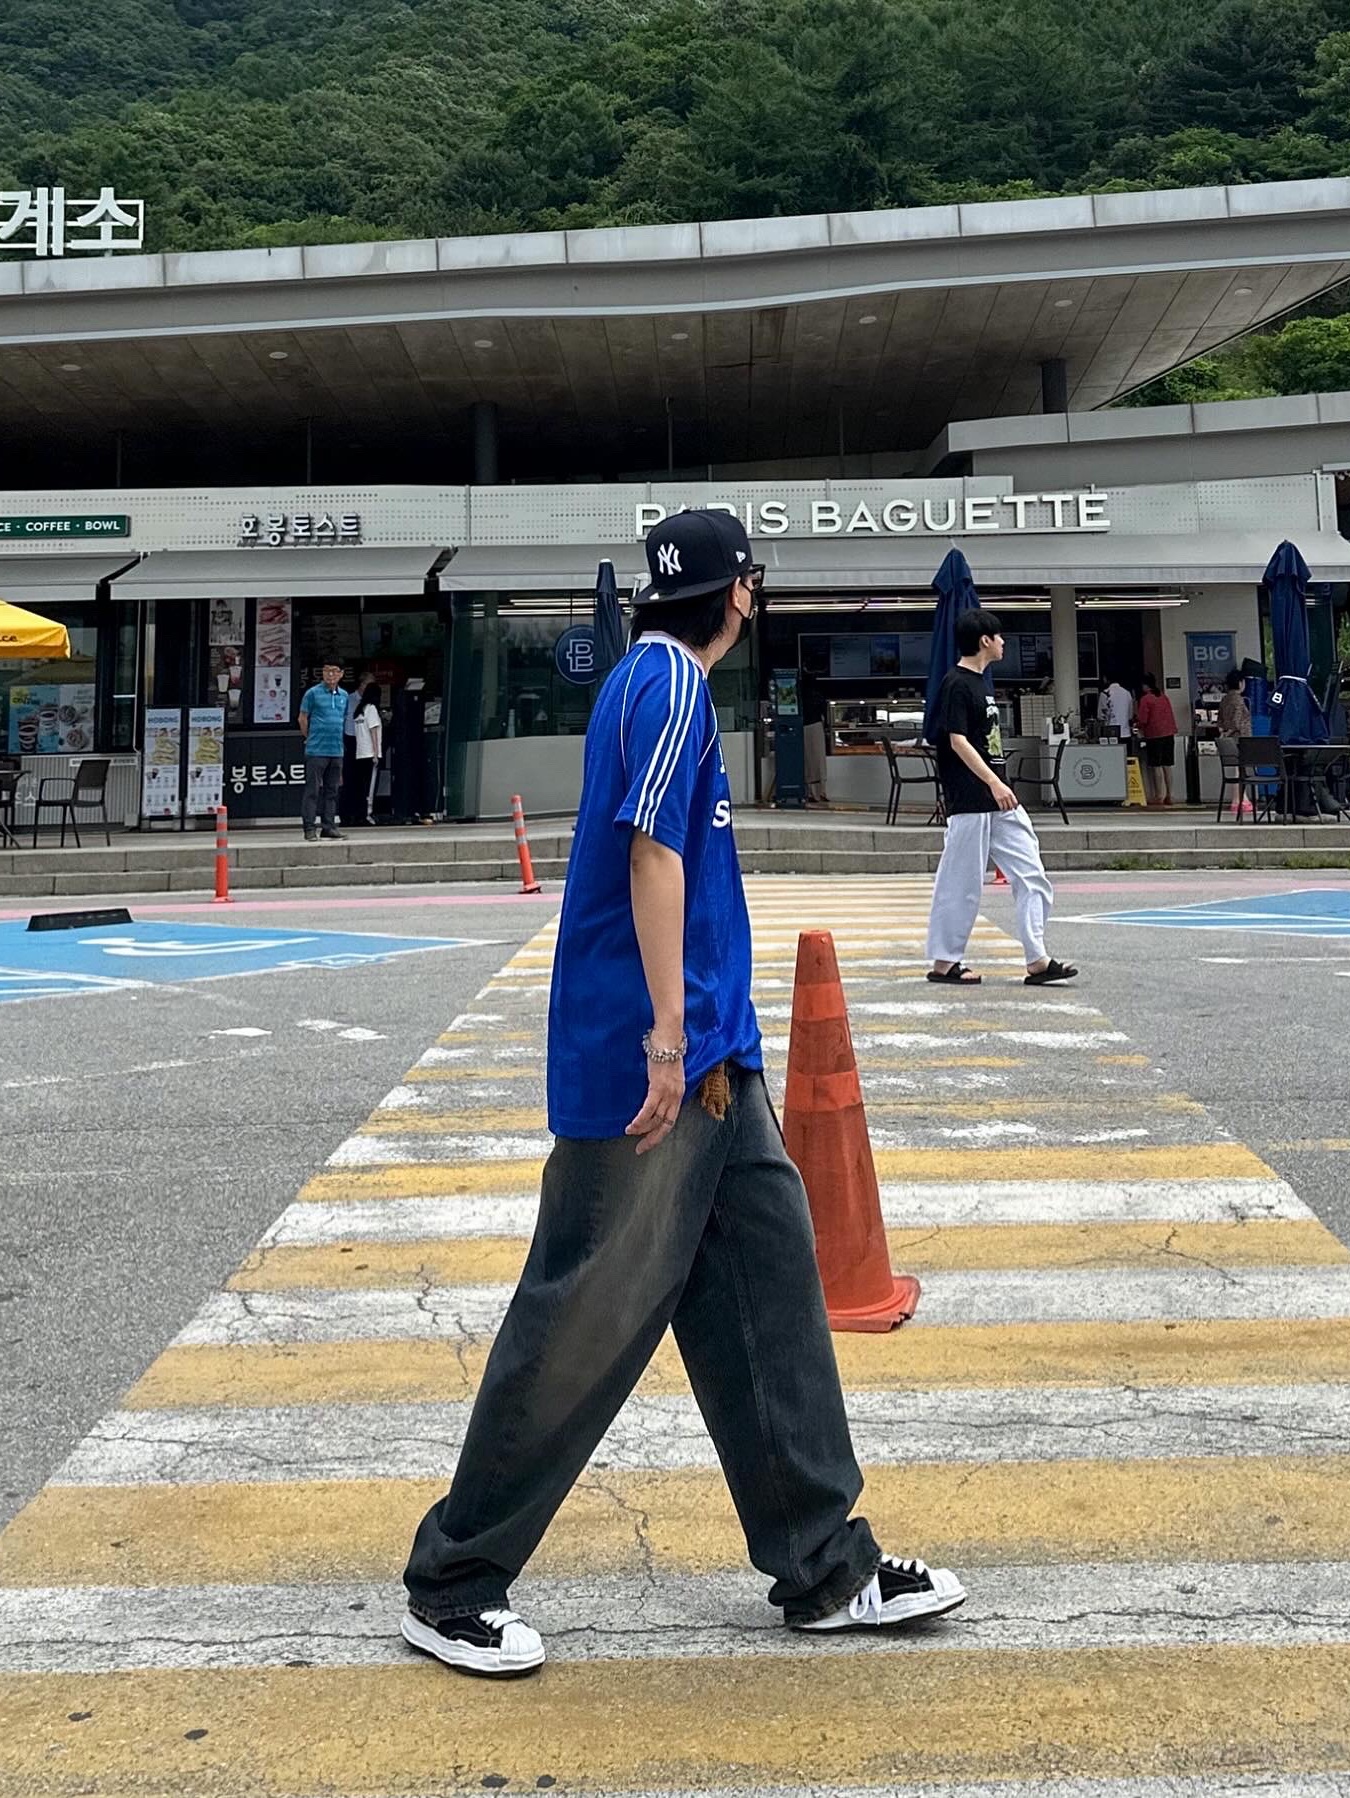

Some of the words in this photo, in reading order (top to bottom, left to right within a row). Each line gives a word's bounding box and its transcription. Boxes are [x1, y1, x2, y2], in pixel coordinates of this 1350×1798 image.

[25, 521, 71, 532] COFFEE
[84, 520, 121, 531] BOWL
[636, 501, 789, 536] PIS
[811, 494, 1111, 533] BAGUETTE
[1193, 645, 1230, 661] BIG
[222, 764, 306, 794] 봉토스트
[712, 799, 731, 828] S
